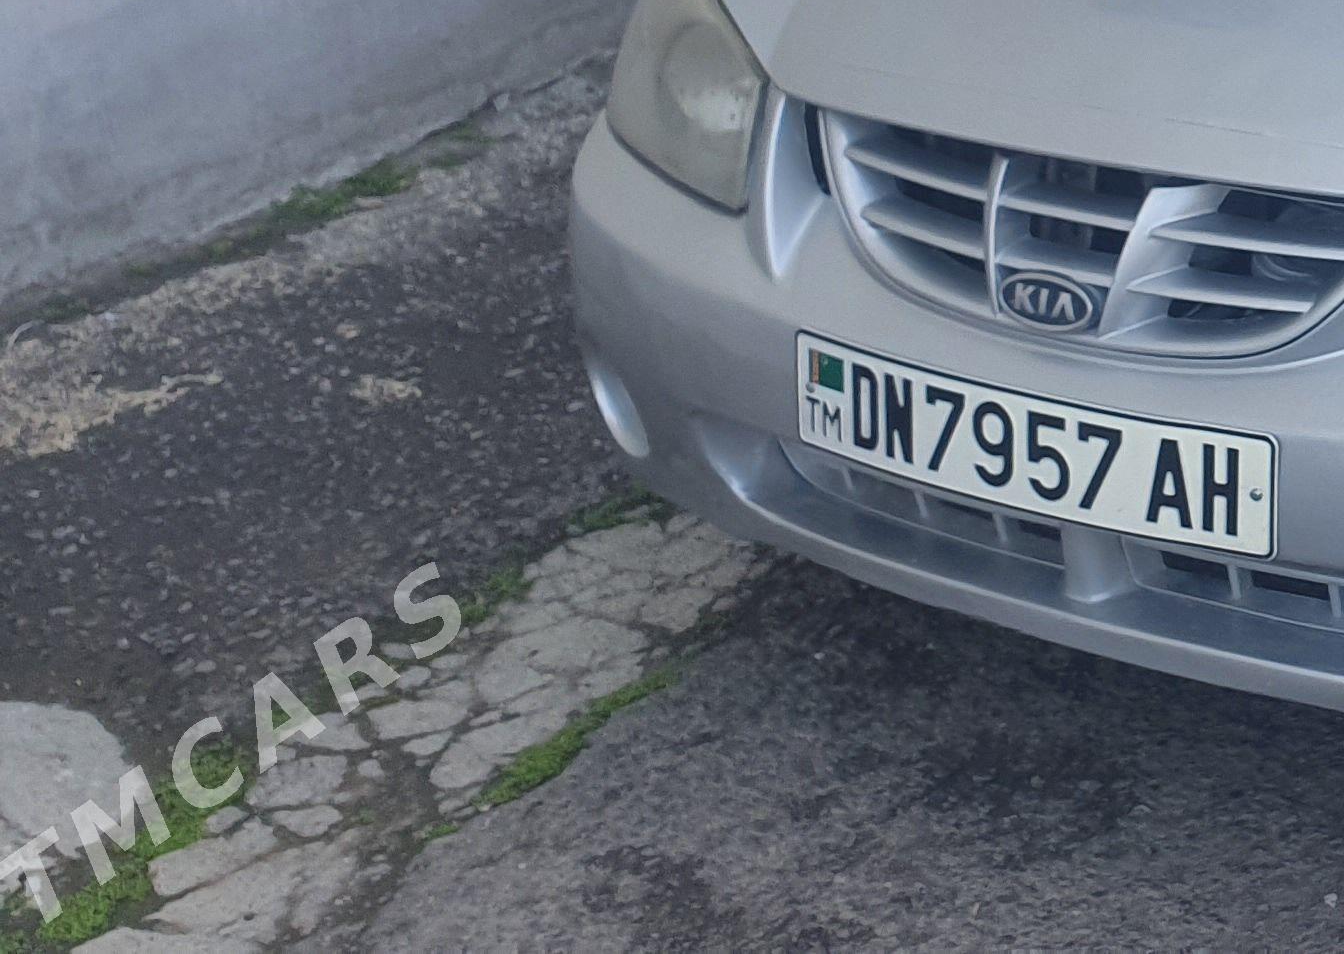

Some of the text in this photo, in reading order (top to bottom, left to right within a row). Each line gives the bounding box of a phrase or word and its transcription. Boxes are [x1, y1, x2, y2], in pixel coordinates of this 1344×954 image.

[1013, 282, 1076, 322] KIA
[805, 394, 843, 443] TM
[852, 362, 1240, 537] DN7957 AH
